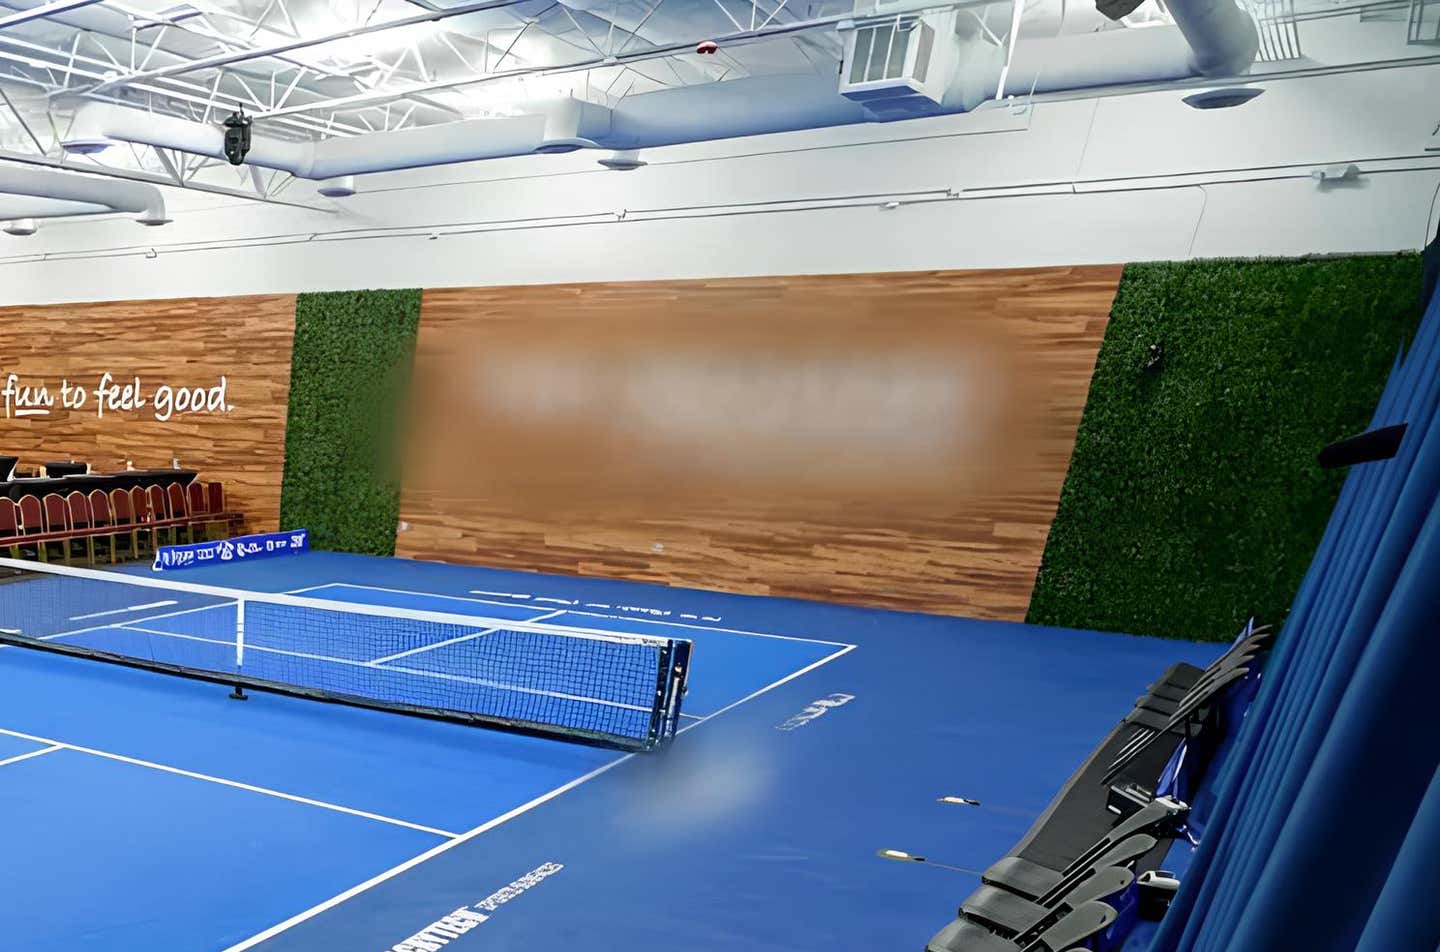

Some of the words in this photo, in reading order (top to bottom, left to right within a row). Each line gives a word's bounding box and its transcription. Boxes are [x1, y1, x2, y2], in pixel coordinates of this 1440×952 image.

[1, 374, 54, 418] fun
[60, 379, 87, 408] to
[93, 371, 146, 419] feel
[154, 375, 236, 421] good.
